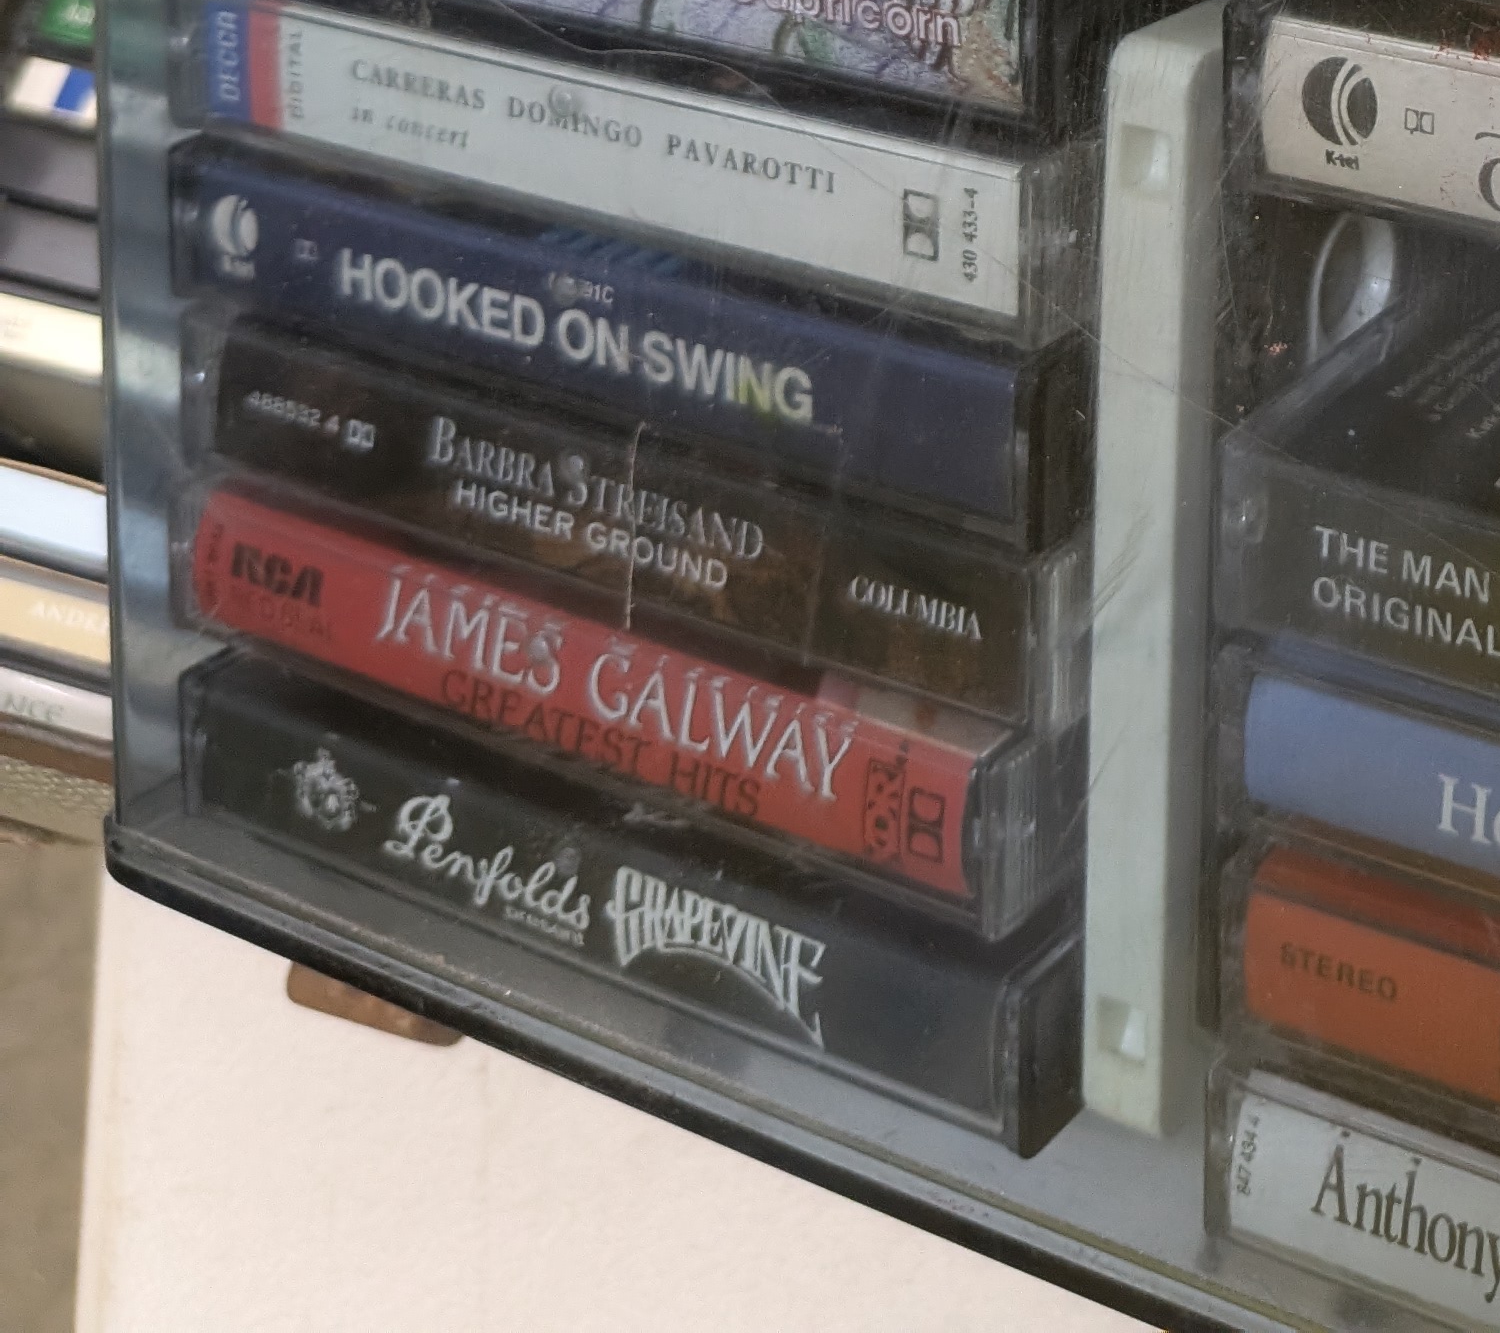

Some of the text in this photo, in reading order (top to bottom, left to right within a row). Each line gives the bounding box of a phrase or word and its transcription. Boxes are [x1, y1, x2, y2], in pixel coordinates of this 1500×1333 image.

[216, 11, 240, 101] DECCA
[667, 133, 836, 193] PAVAROTTI
[961, 186, 979, 282] 430 433-4
[337, 248, 814, 424] HOOKED ON SWING
[454, 479, 728, 590] HIGHER GROUND
[1315, 526, 1388, 573] THE
[1402, 553, 1490, 604] MAN
[377, 575, 852, 801] JAMES GALWAY
